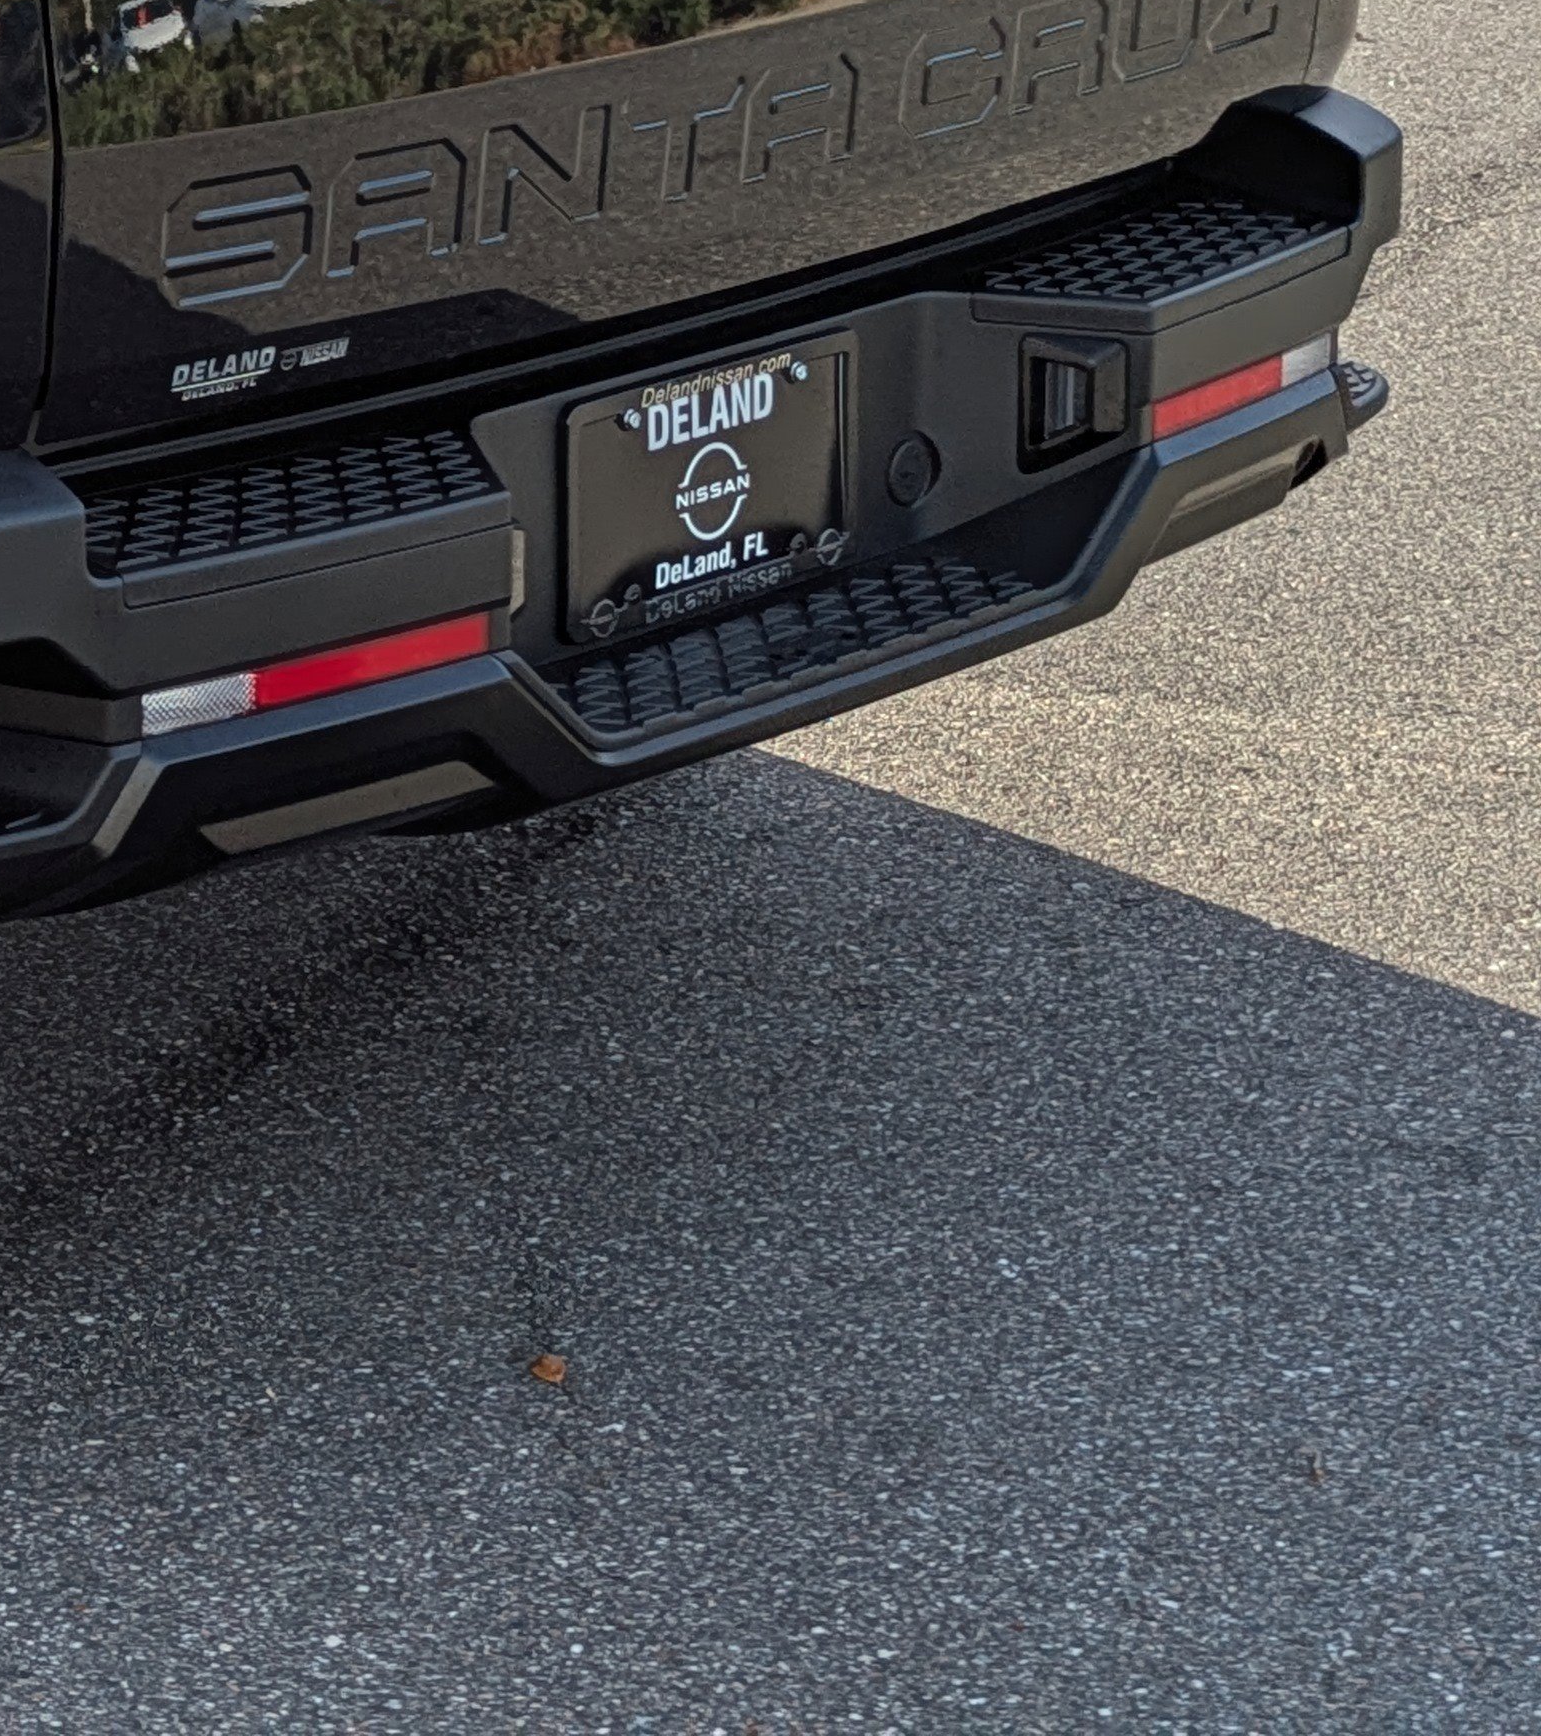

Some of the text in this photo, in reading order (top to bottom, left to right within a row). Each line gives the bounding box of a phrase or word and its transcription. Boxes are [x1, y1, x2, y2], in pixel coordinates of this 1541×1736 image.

[162, 53, 858, 307] SANTA
[171, 346, 276, 386] DELAND
[647, 372, 774, 452] DELAND
[675, 472, 751, 510] NISSAN
[655, 532, 768, 590] DeLand, FL
